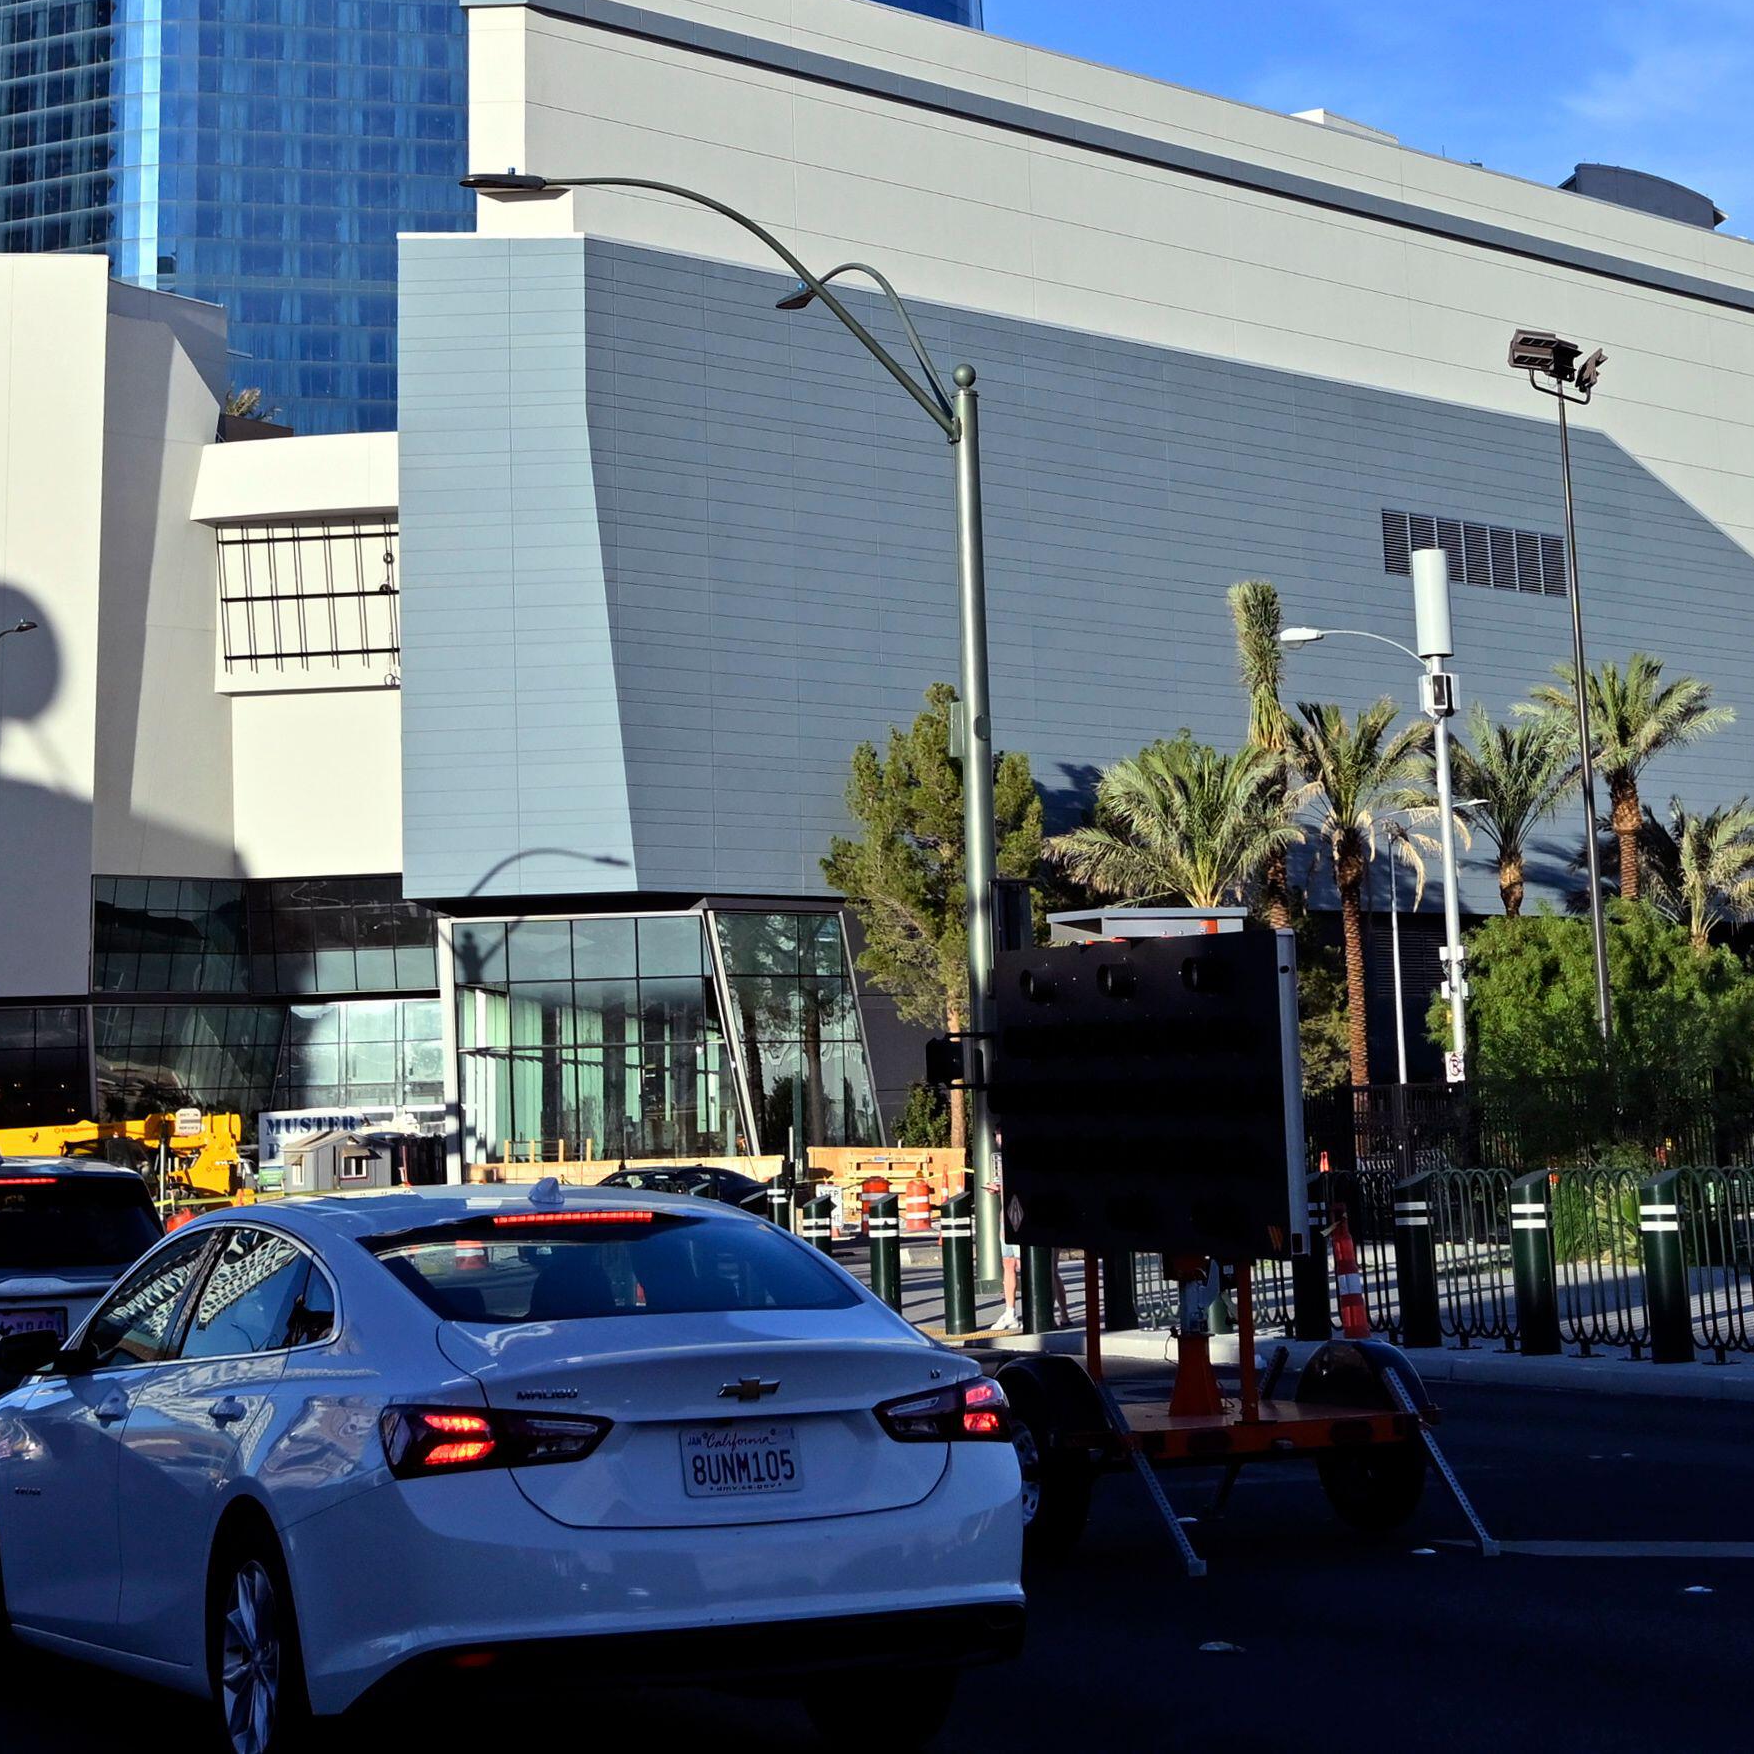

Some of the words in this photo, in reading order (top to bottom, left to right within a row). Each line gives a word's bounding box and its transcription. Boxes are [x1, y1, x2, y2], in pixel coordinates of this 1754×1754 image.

[266, 1115, 356, 1135] MUSTER
[516, 1388, 579, 1400] MALIBU
[687, 1436, 703, 1446] JAN
[706, 1431, 777, 1451] California
[692, 1449, 795, 1486] 8UNM105
